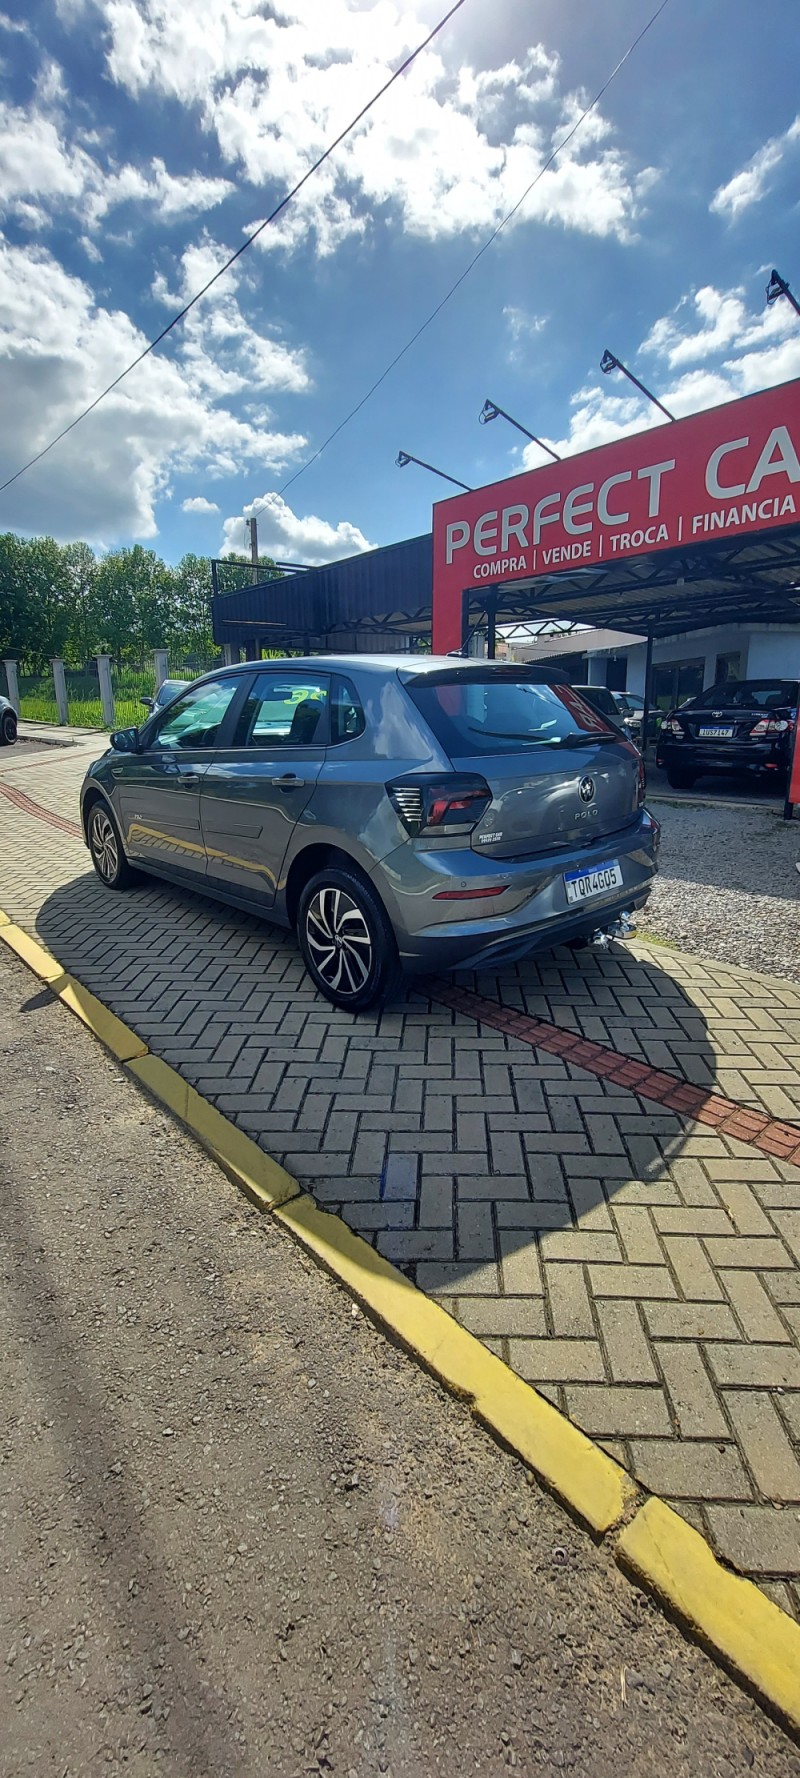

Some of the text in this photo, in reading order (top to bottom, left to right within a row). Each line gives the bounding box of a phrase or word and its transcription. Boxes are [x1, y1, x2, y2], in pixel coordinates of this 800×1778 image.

[446, 459, 676, 564] PERFECT
[473, 494, 796, 579] COMPRA VENDE TROCA FINANCIA
[575, 809, 598, 820] POLO
[571, 868, 617, 898] TQR4G05
